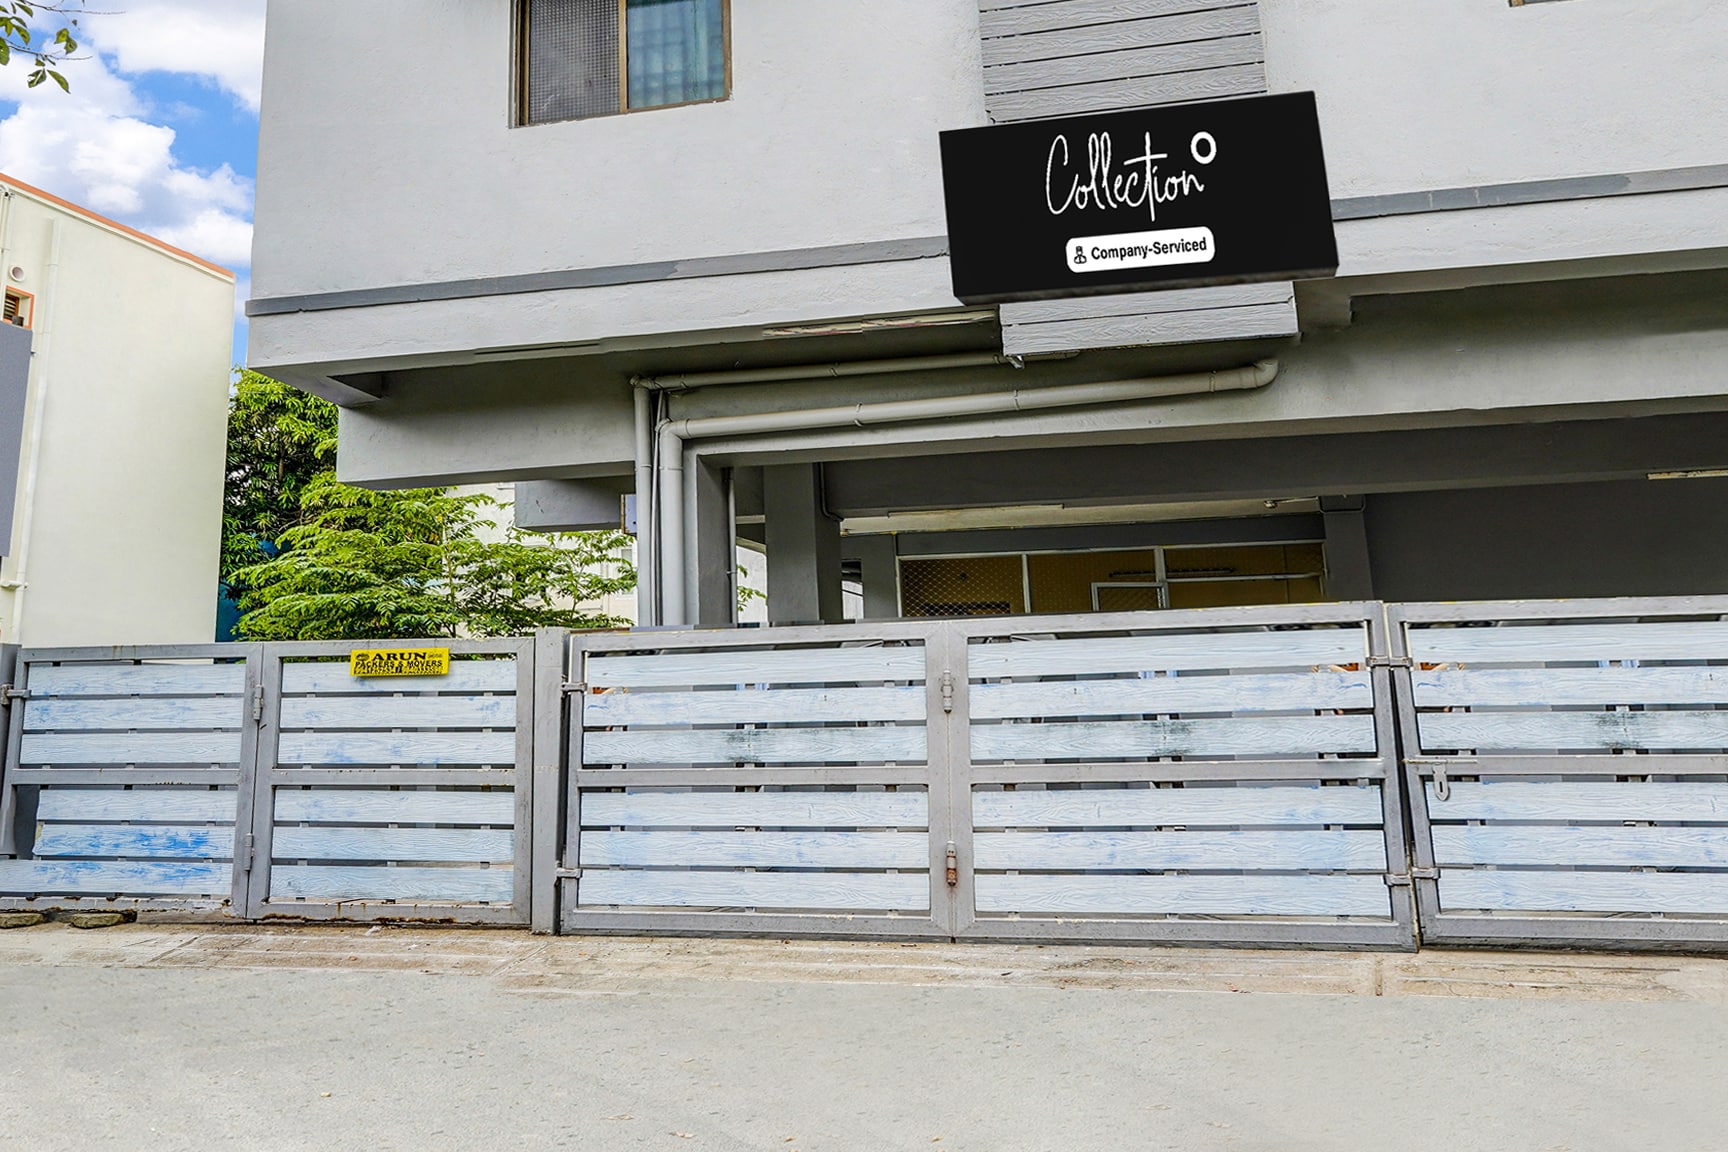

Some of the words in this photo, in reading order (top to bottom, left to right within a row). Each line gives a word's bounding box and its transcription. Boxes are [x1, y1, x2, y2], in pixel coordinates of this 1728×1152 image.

[1045, 131, 1205, 222] Collection
[1091, 237, 1207, 261] Company-Serviced
[372, 652, 427, 661] ARUN
